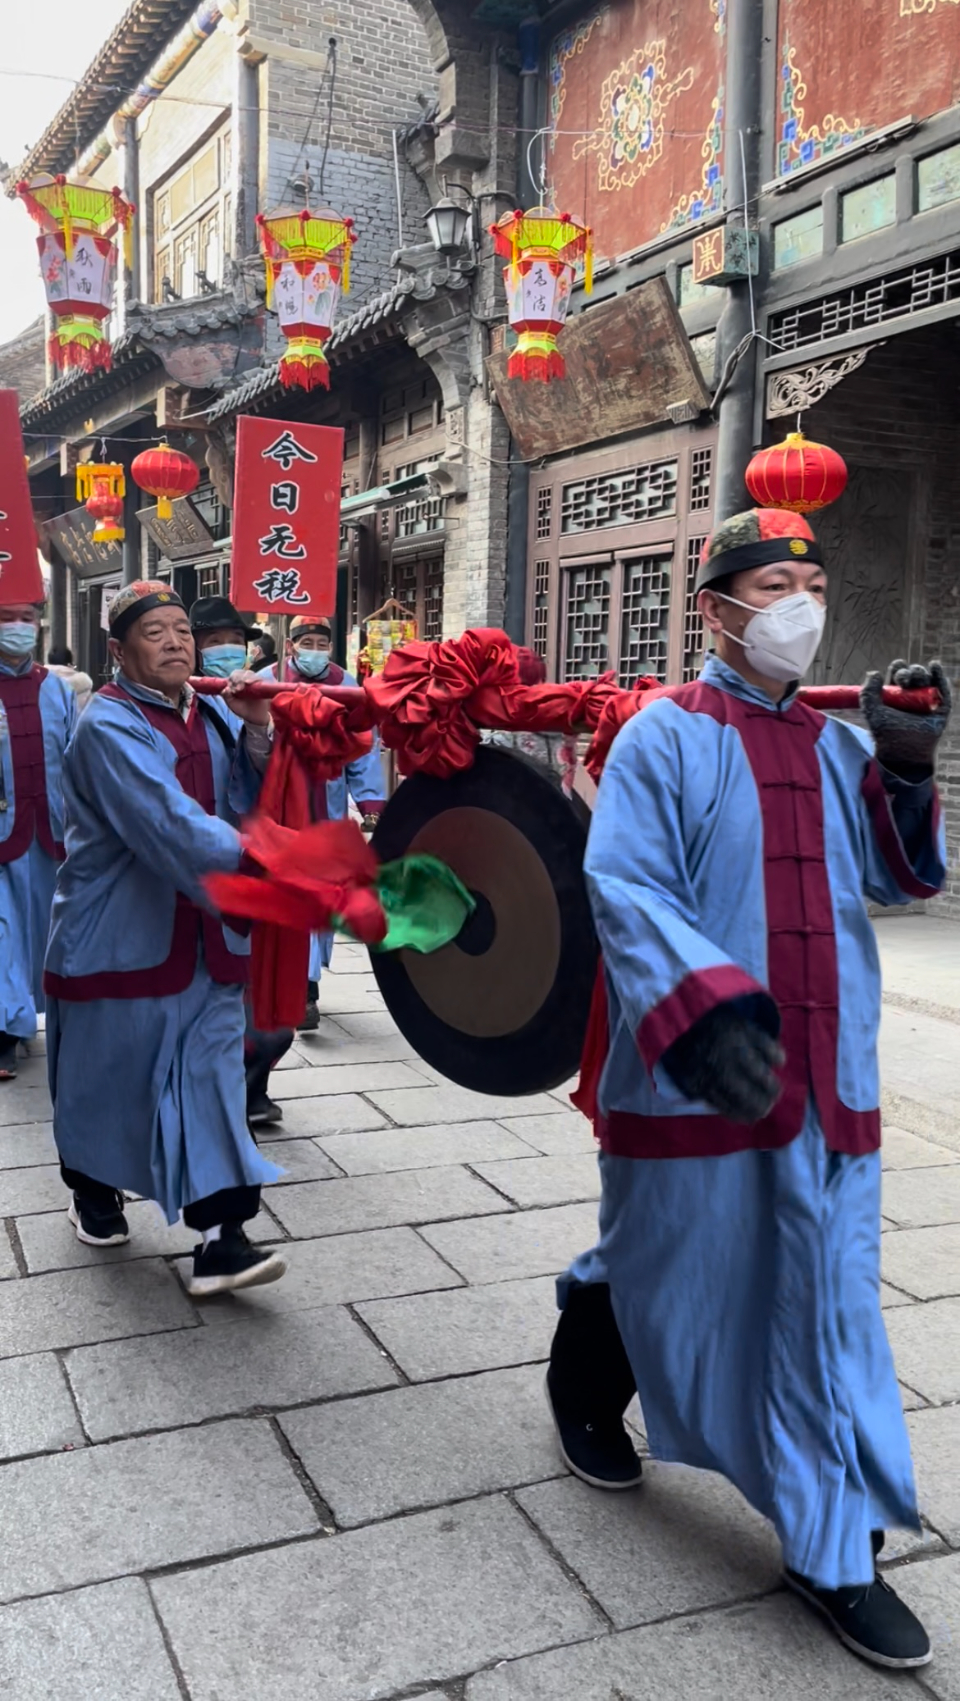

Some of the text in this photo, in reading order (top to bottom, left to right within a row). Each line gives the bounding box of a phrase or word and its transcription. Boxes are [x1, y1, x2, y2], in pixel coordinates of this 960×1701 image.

[75, 246, 94, 295] 秋雨
[533, 268, 547, 312] 高洁
[253, 430, 318, 604] 今日无税
